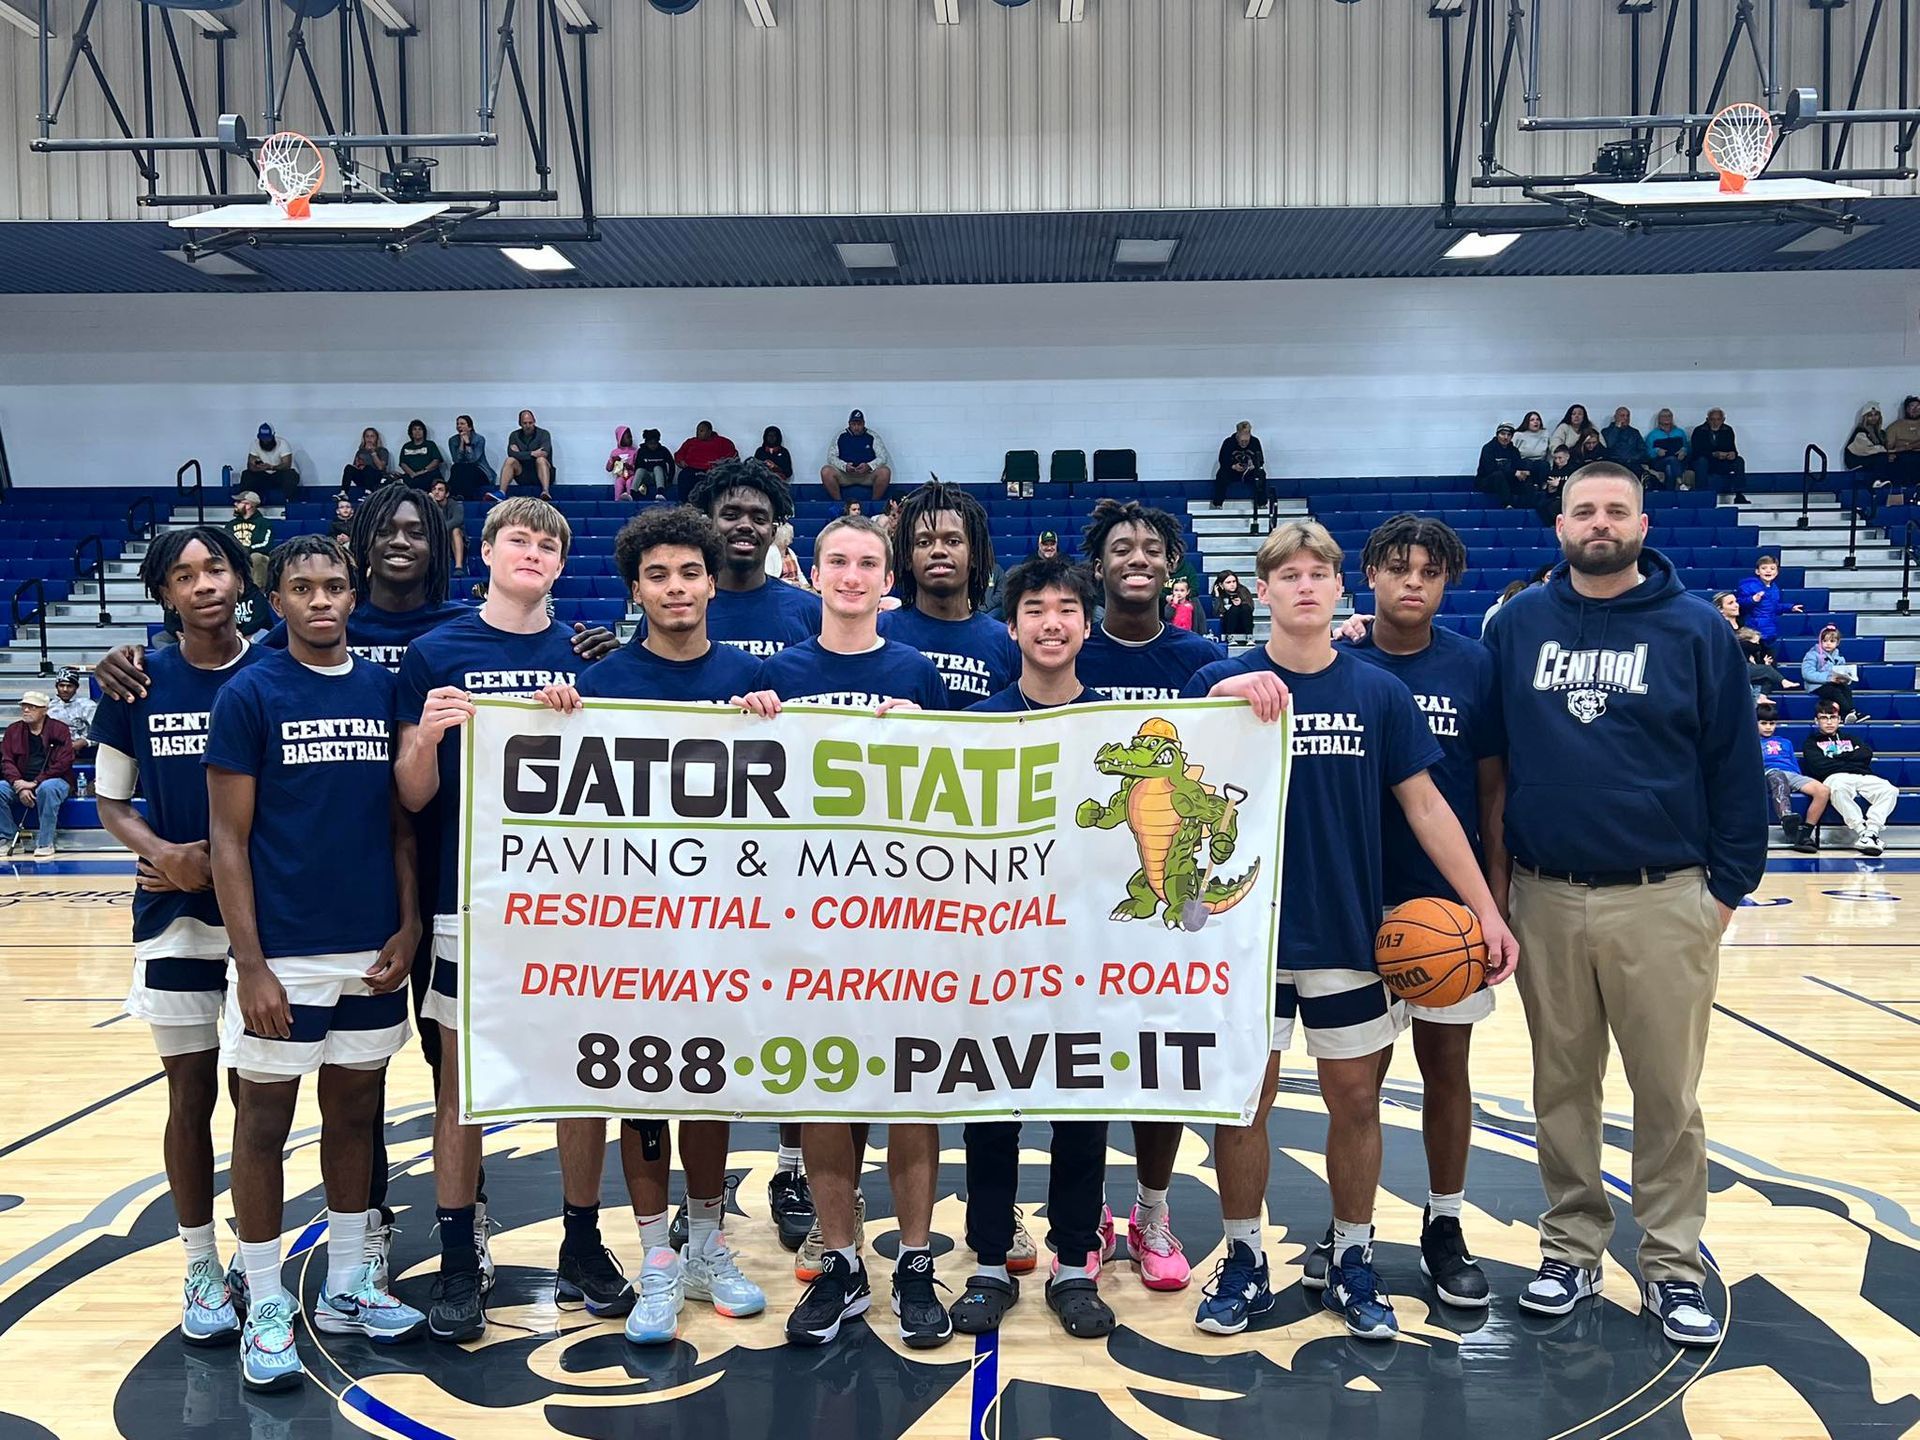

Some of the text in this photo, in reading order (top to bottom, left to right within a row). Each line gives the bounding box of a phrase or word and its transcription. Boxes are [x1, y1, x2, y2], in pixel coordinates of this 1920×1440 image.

[1533, 641, 1649, 694] CENTRAL
[281, 719, 390, 740] CENTRAL
[503, 734, 1061, 827] GATOR STATE
[501, 834, 1056, 885] PAVING & MASONRY
[504, 892, 771, 929] RESIDENTIAL
[811, 893, 1067, 936] COMMERCIAL
[521, 962, 750, 1003] DRIVEWAYS
[786, 968, 959, 1003] PARKING
[969, 964, 1063, 1005] LOTS
[1099, 961, 1230, 996] ROADS
